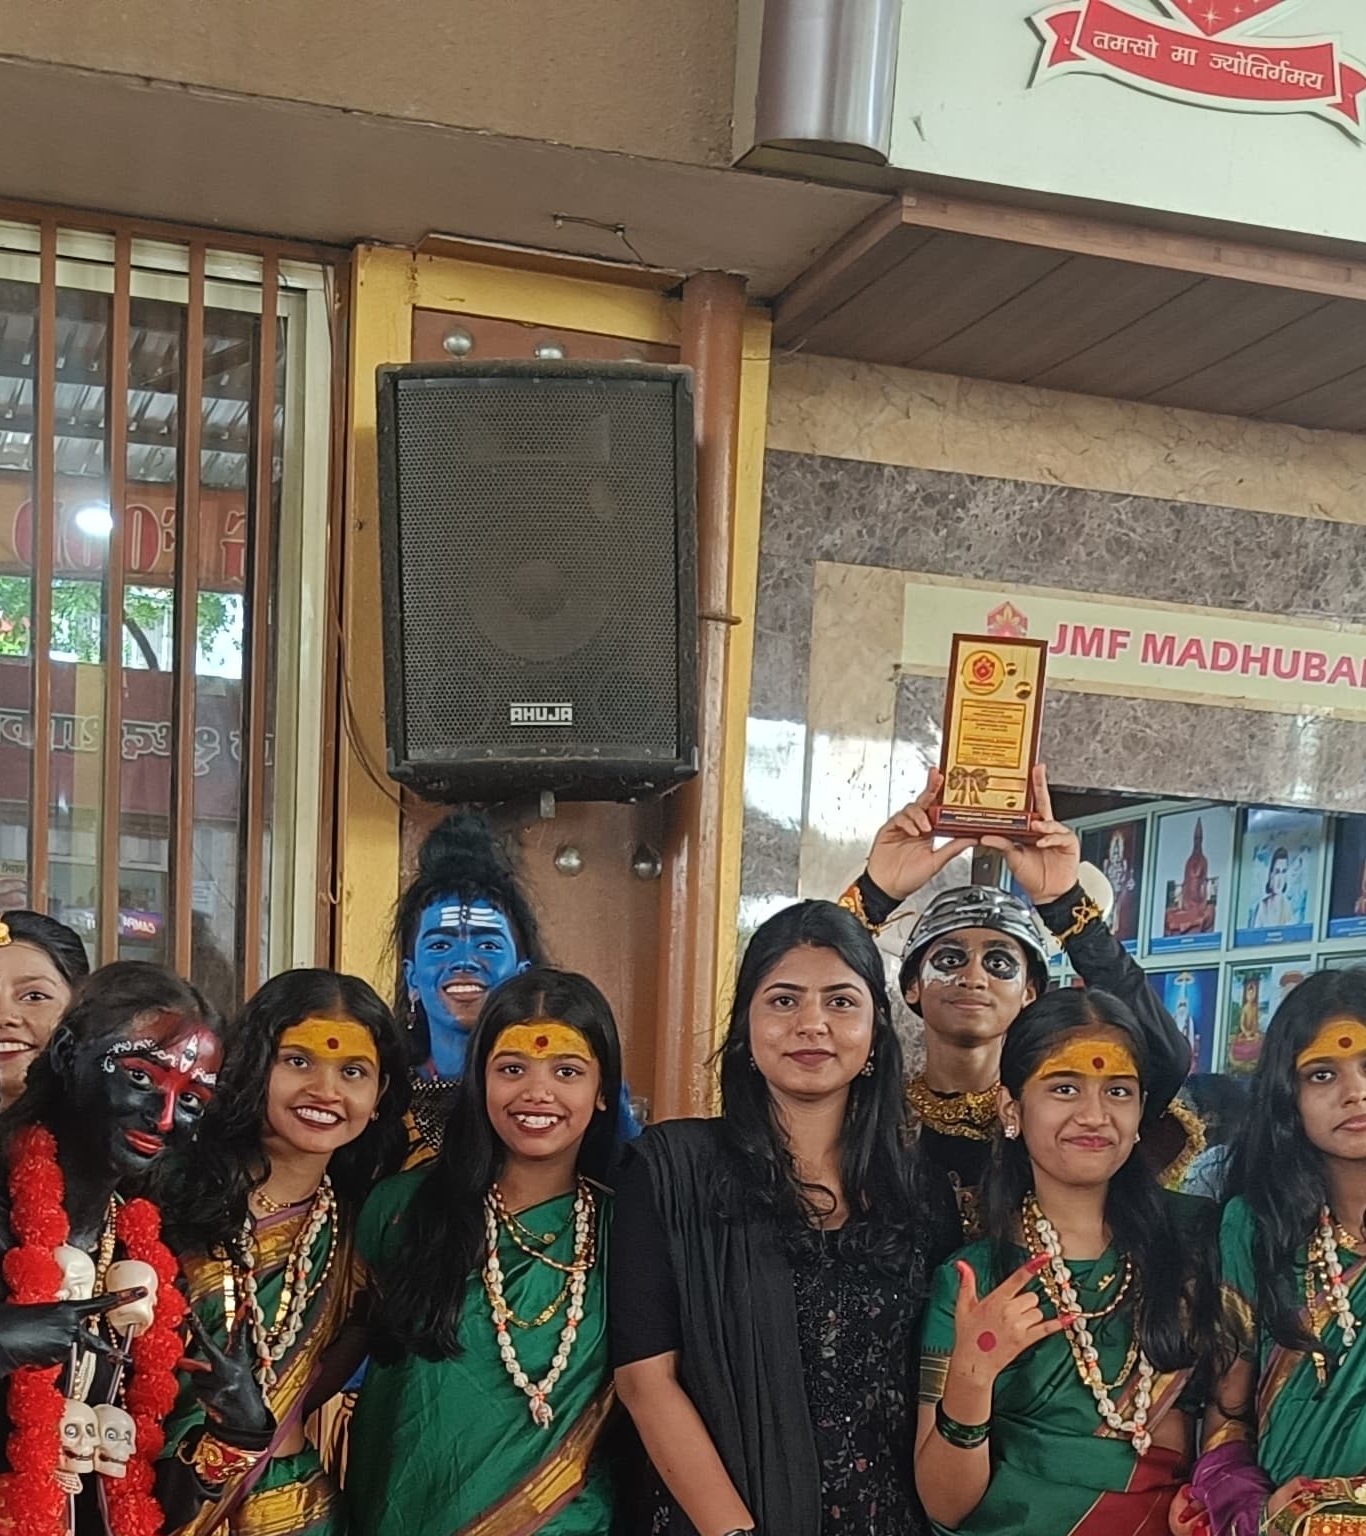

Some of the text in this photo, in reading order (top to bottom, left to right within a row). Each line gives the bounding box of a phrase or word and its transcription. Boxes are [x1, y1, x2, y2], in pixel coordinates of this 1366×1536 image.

[1170, 45, 1199, 66] मा
[1209, 52, 1325, 91] ज्योतिर्गमय
[1049, 623, 1130, 660] JMF
[510, 706, 573, 722] AHUJA
